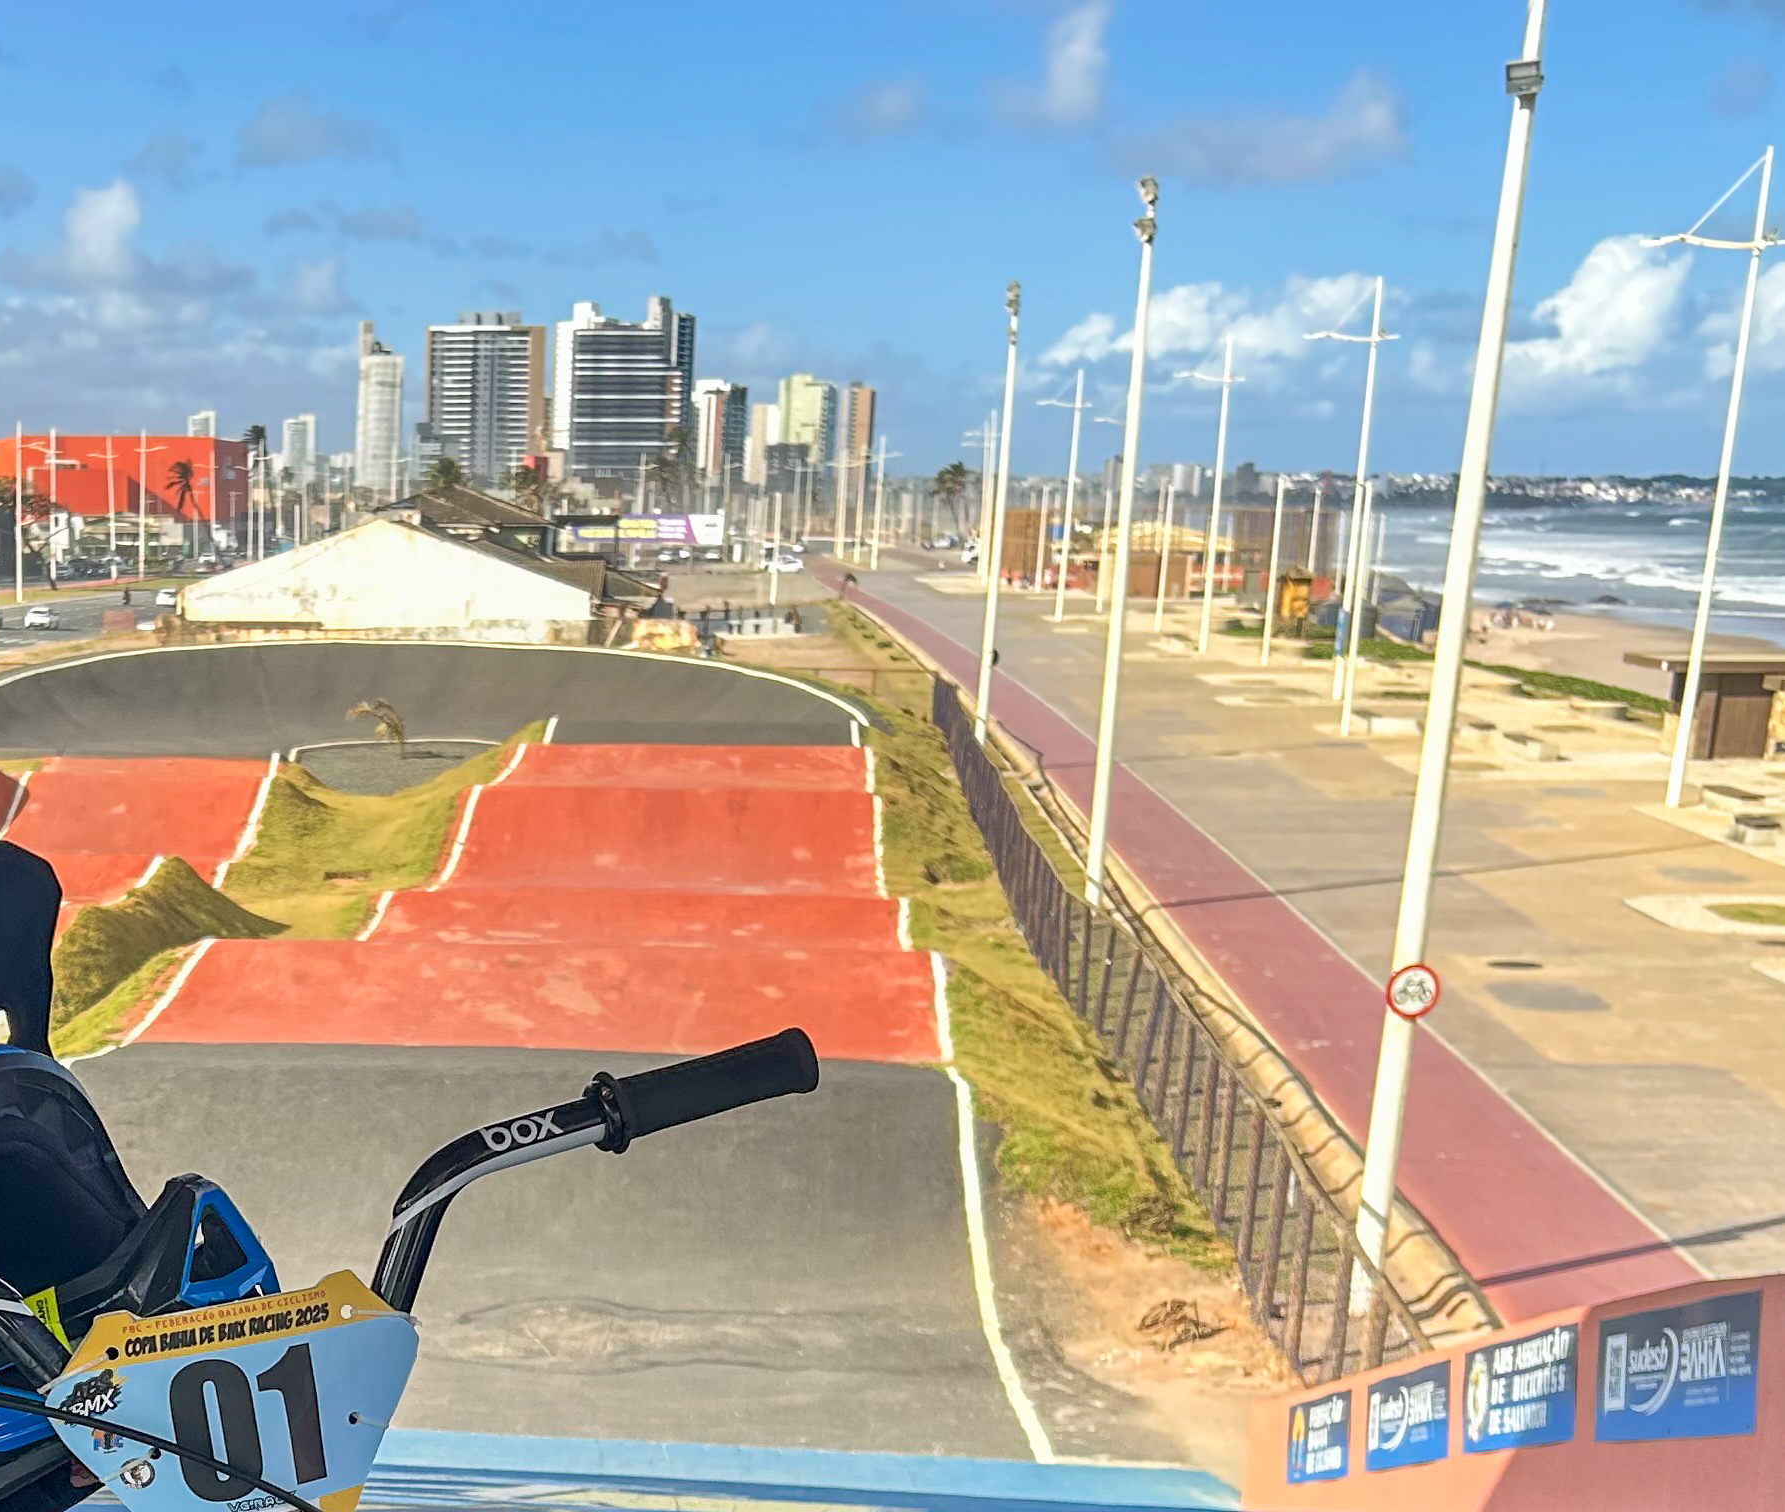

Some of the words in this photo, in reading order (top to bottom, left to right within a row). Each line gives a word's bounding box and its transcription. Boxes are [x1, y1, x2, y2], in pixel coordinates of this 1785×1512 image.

[479, 1112, 564, 1152] box
[124, 1334, 158, 1358] COPA
[199, 1324, 214, 1346] DE
[218, 1320, 248, 1342] BMX
[249, 1310, 293, 1337] RACING
[295, 1303, 330, 1328] 2025
[169, 1342, 328, 1502] 01
